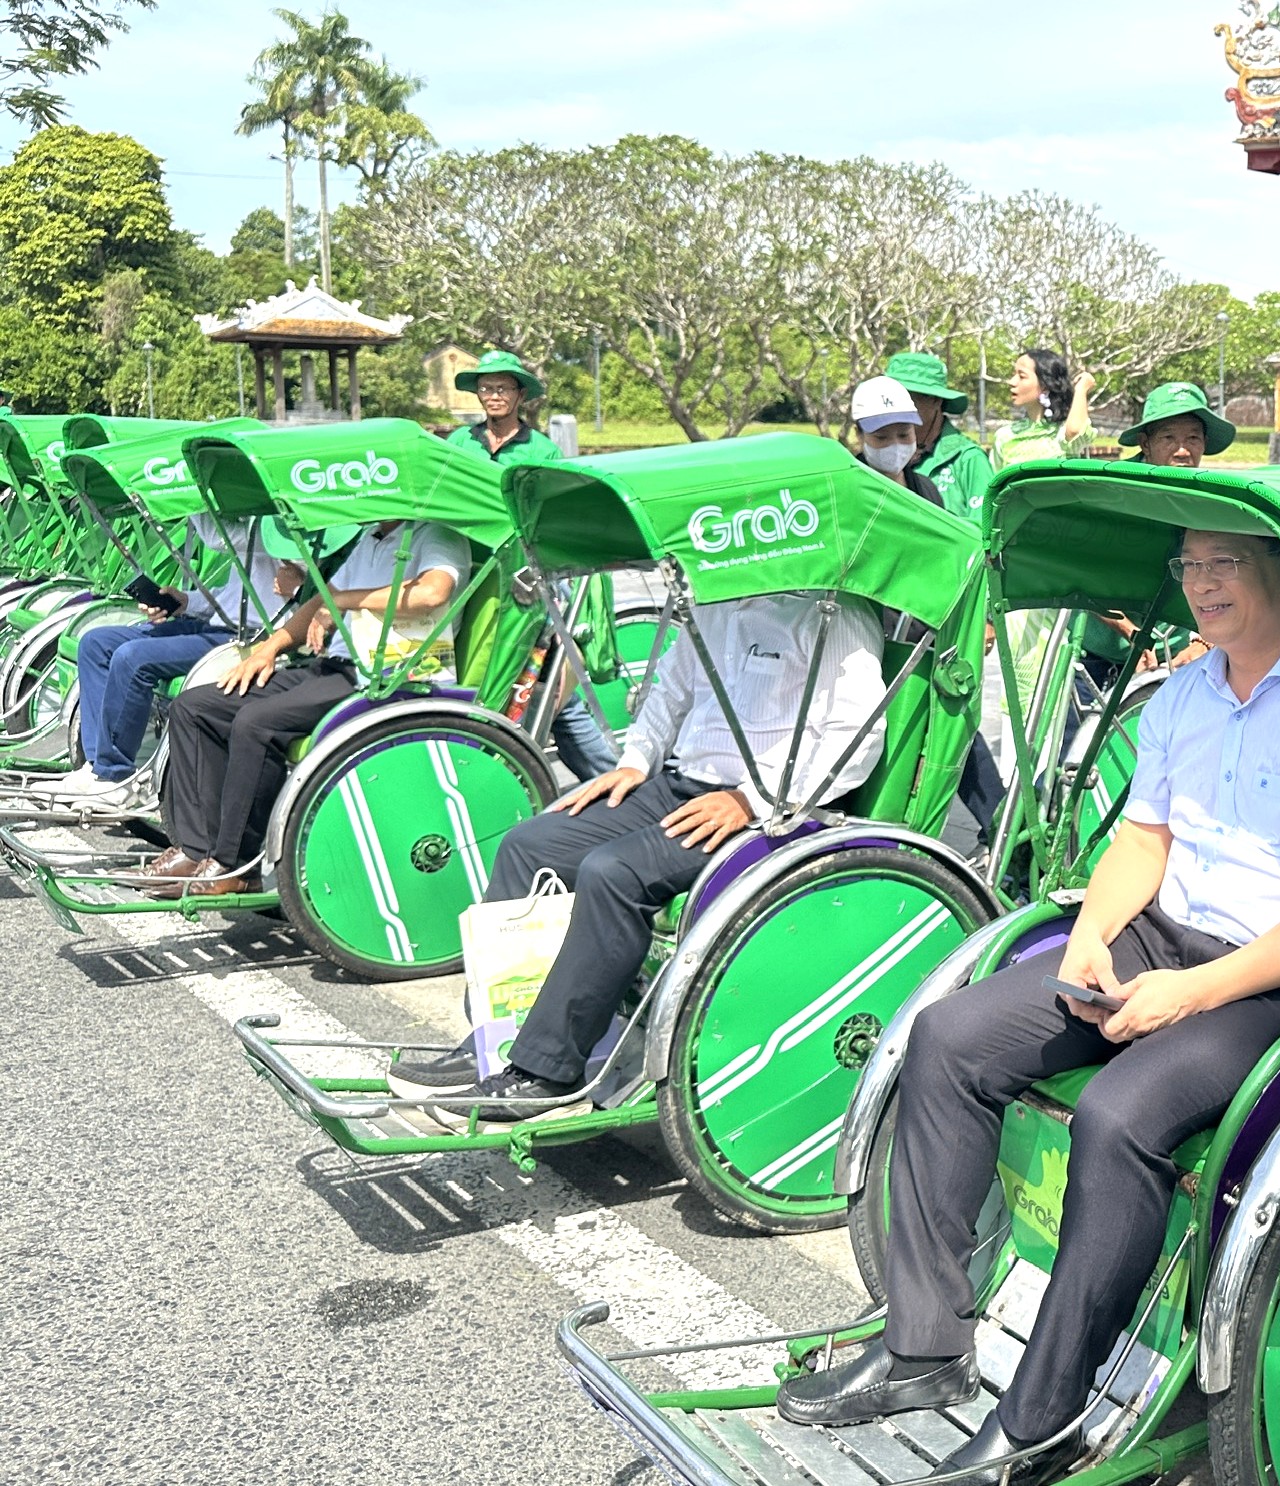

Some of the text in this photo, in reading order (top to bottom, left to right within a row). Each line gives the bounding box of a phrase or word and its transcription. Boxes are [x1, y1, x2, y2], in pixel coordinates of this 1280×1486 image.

[143, 456, 188, 485] Gr
[290, 449, 399, 494] Grab
[687, 488, 820, 554] Grab
[1013, 1184, 1060, 1238] Grab
